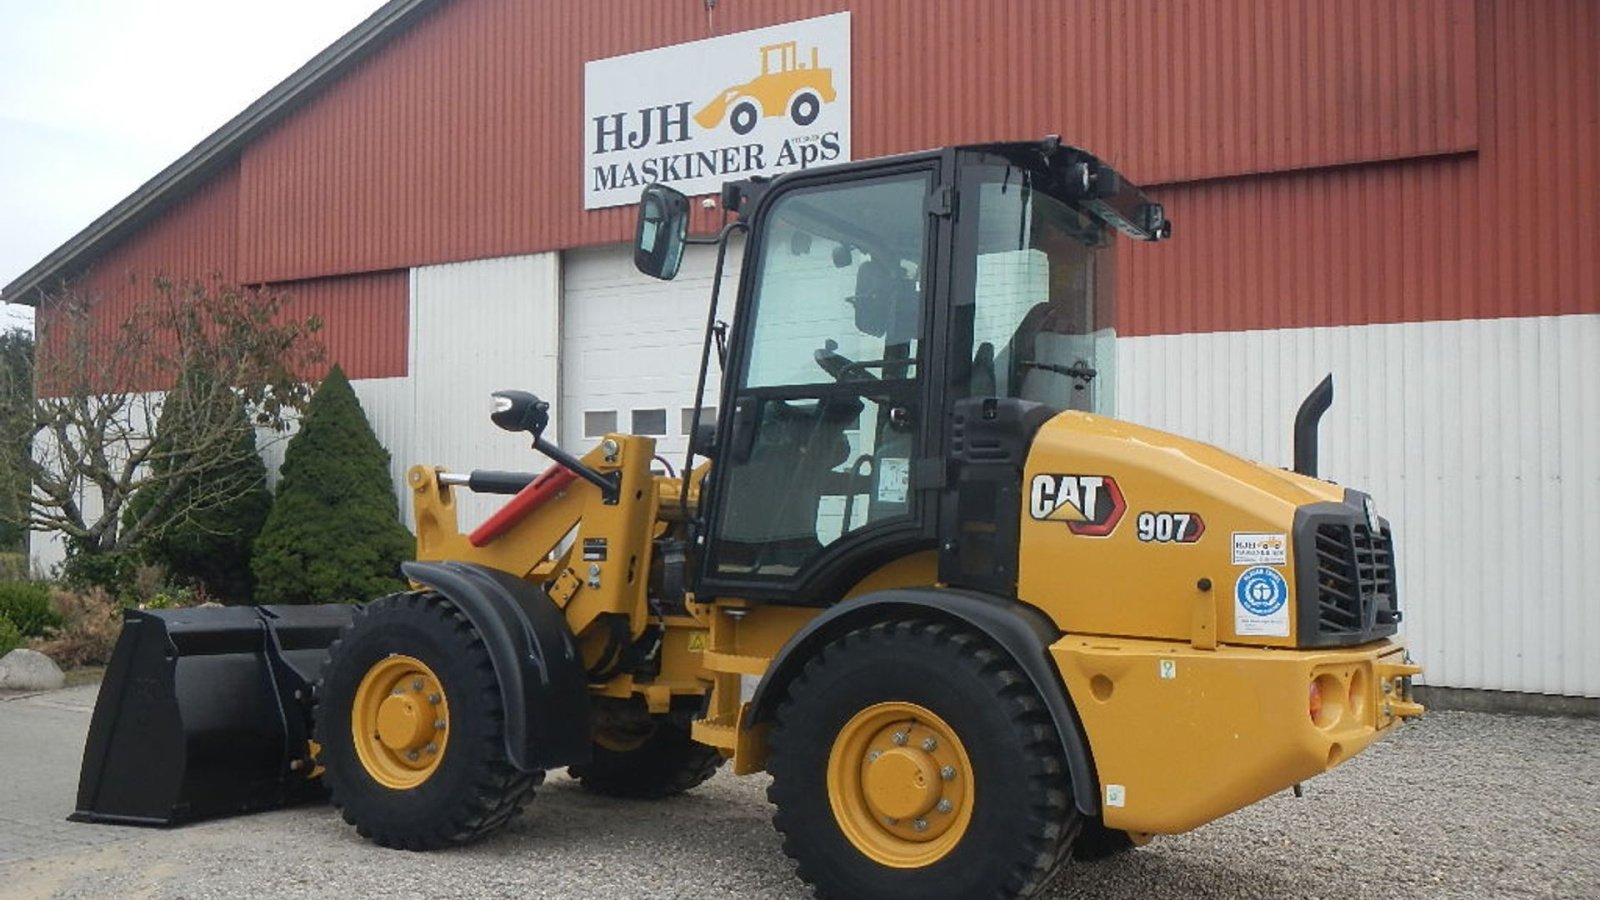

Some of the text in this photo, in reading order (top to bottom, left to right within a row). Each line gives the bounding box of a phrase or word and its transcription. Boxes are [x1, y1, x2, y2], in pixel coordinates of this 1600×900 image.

[592, 101, 693, 155] HJH
[593, 131, 840, 192] MASKINER ApS
[1031, 474, 1103, 522] CAT
[1138, 513, 1190, 541] 907
